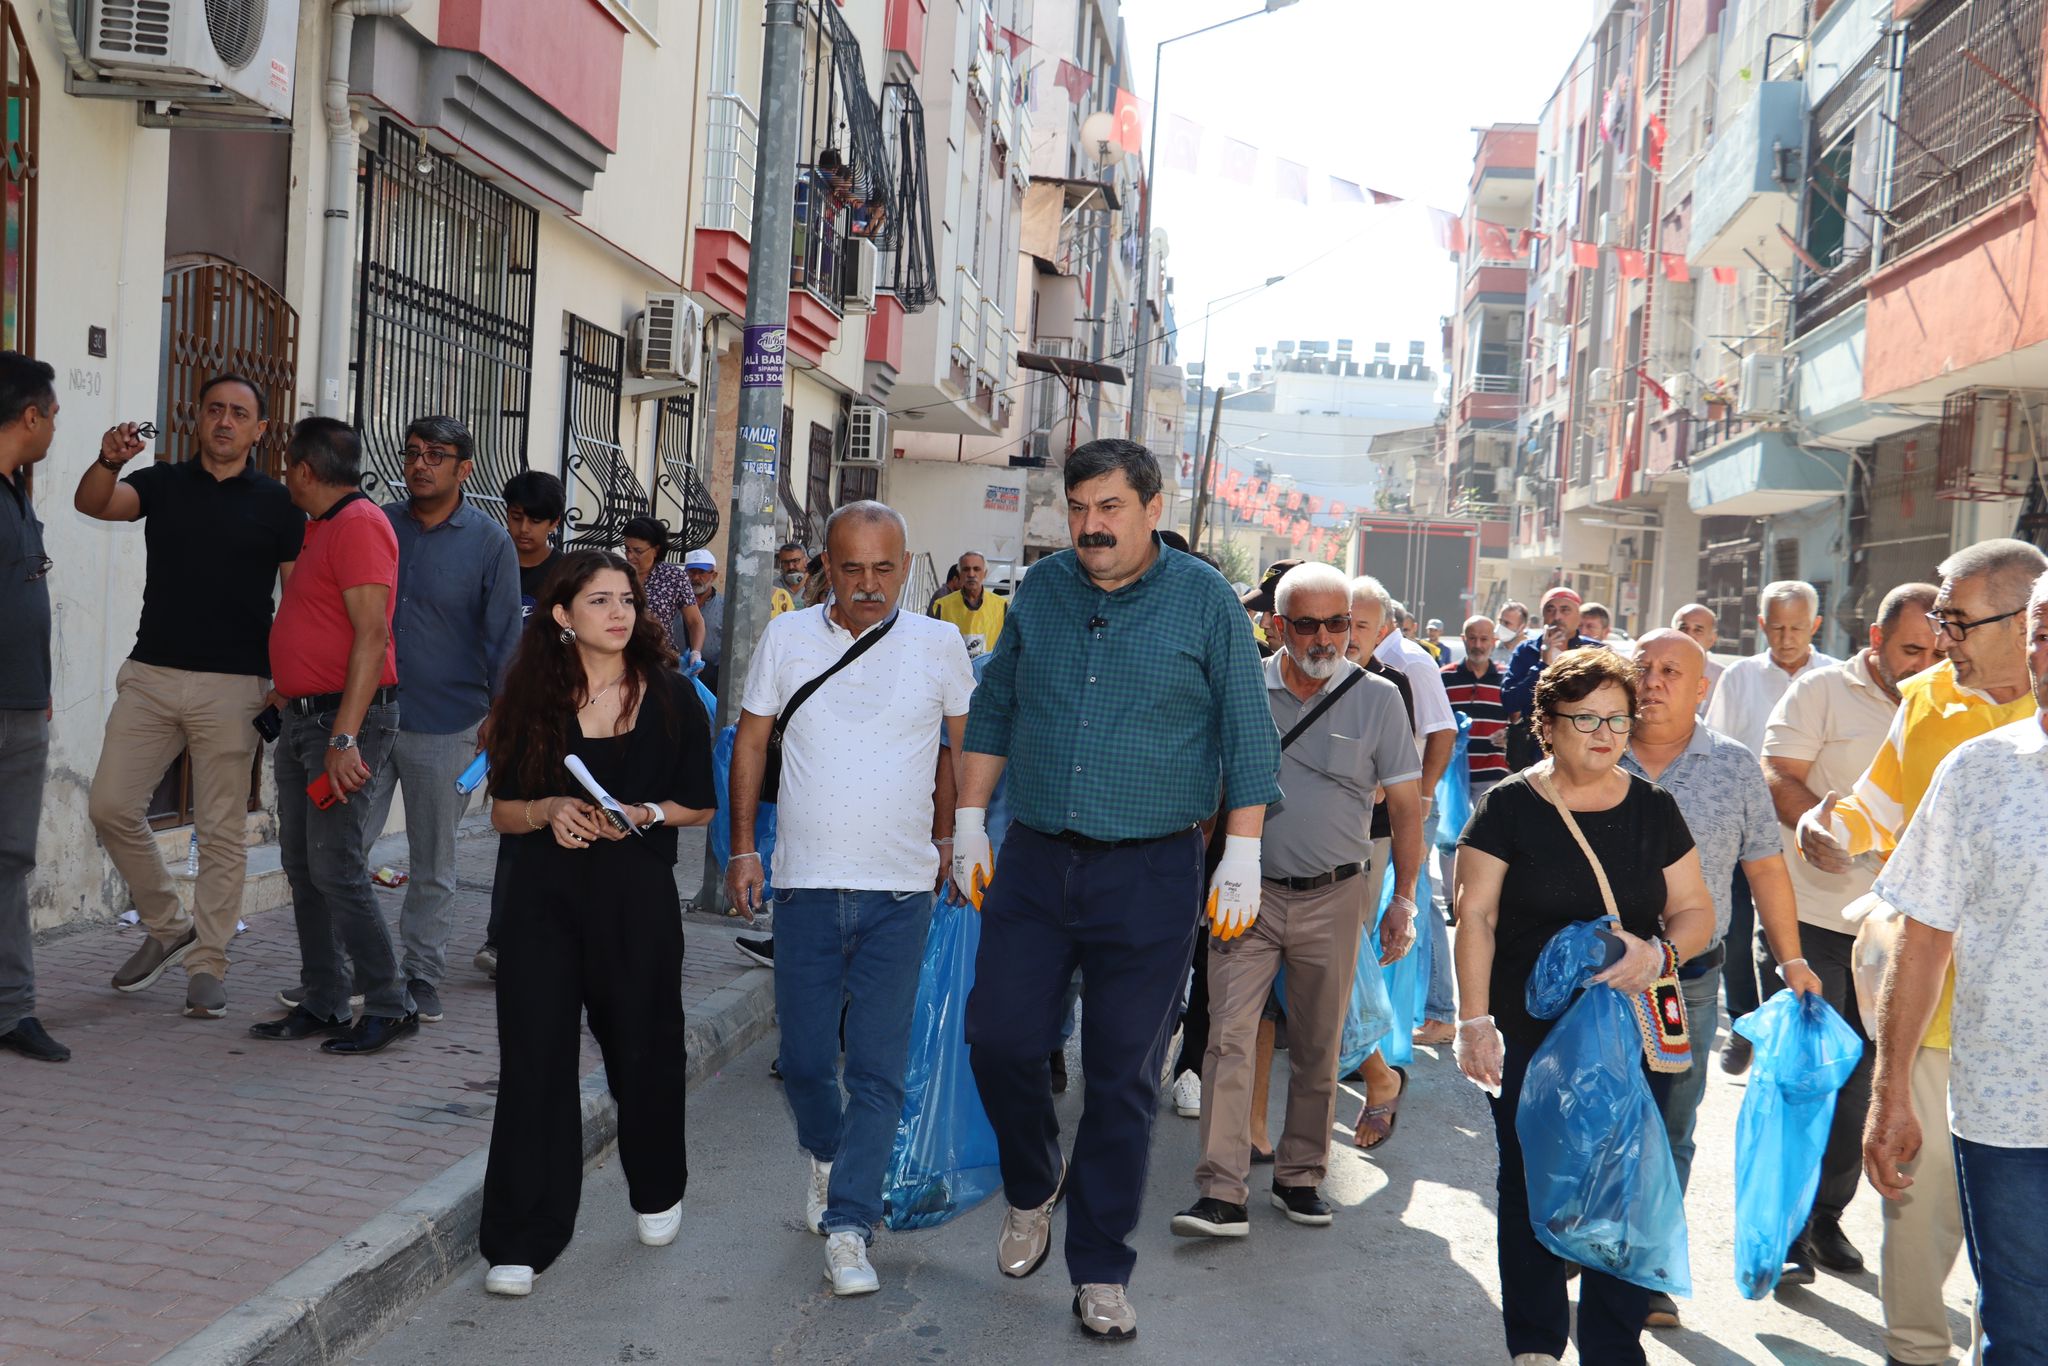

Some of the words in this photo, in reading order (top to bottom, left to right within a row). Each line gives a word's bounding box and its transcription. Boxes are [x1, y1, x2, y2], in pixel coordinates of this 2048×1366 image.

[93, 334, 103, 348] 30
[745, 353, 759, 365] ALİ
[744, 373, 764, 383] 0531
